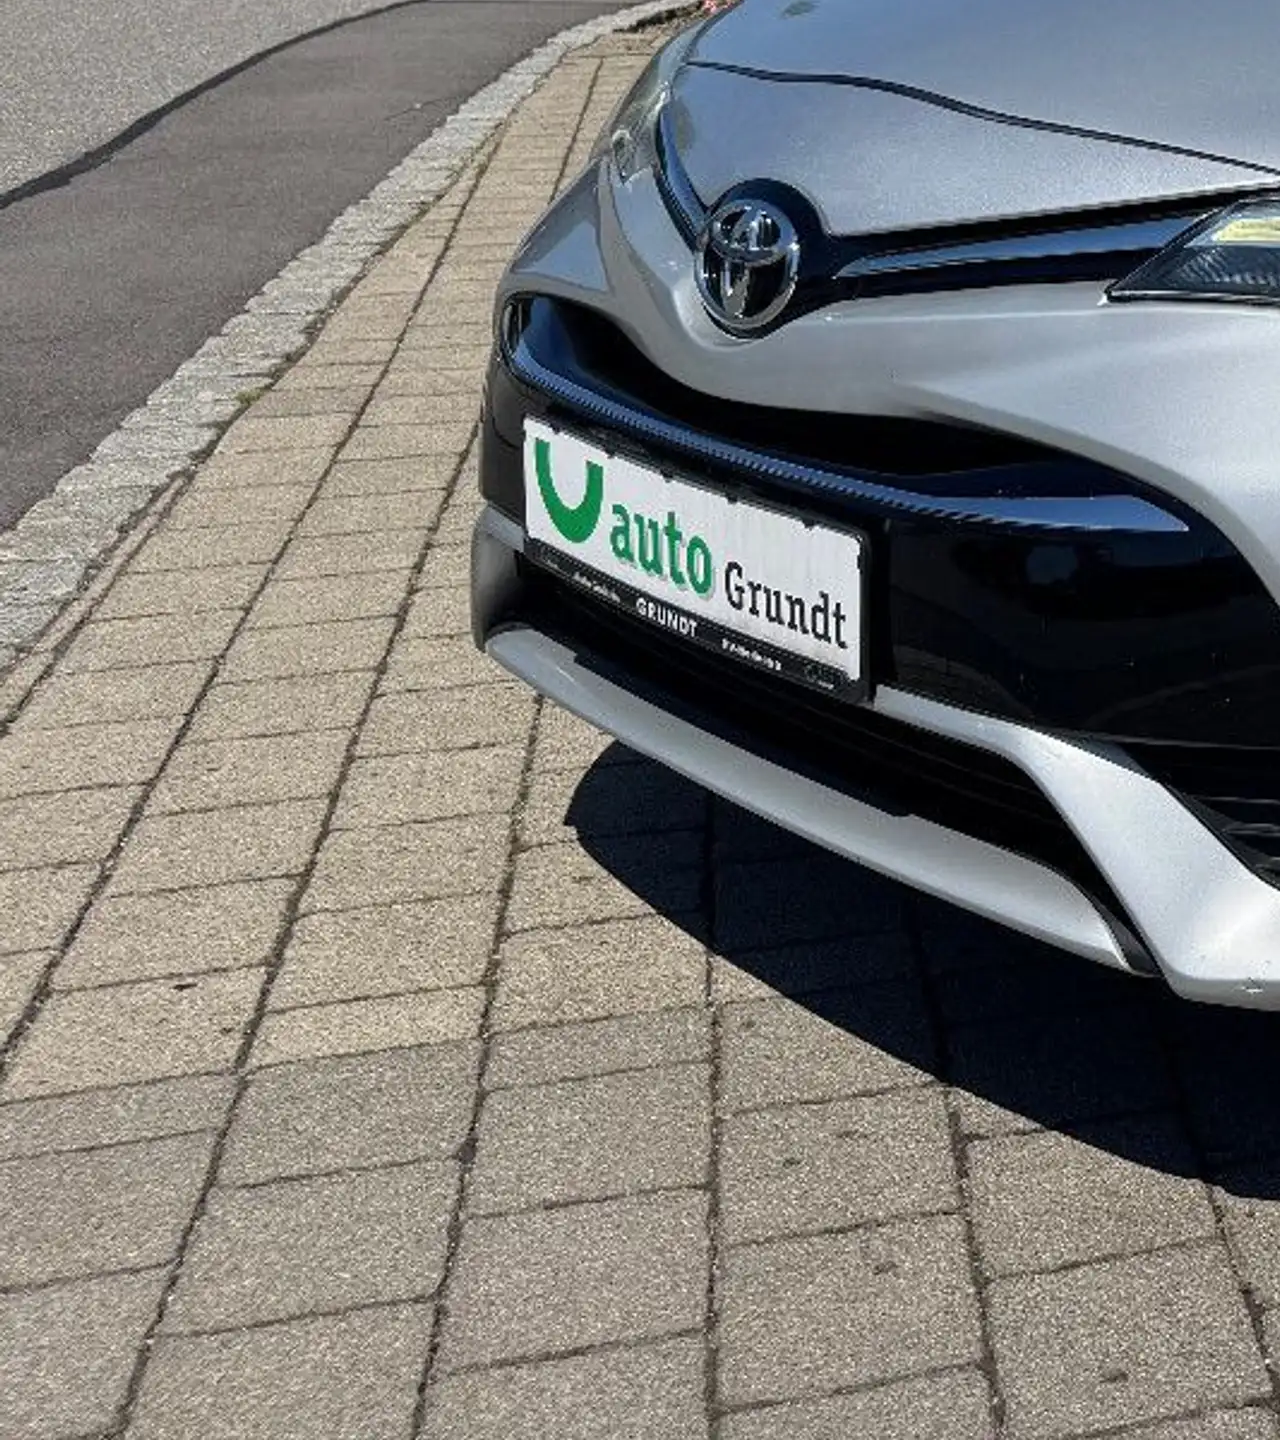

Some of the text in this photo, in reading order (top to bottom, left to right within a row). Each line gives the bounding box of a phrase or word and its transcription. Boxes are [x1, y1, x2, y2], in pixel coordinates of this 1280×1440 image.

[610, 503, 848, 649] auto Grundt
[635, 597, 699, 638] GRUNDT
